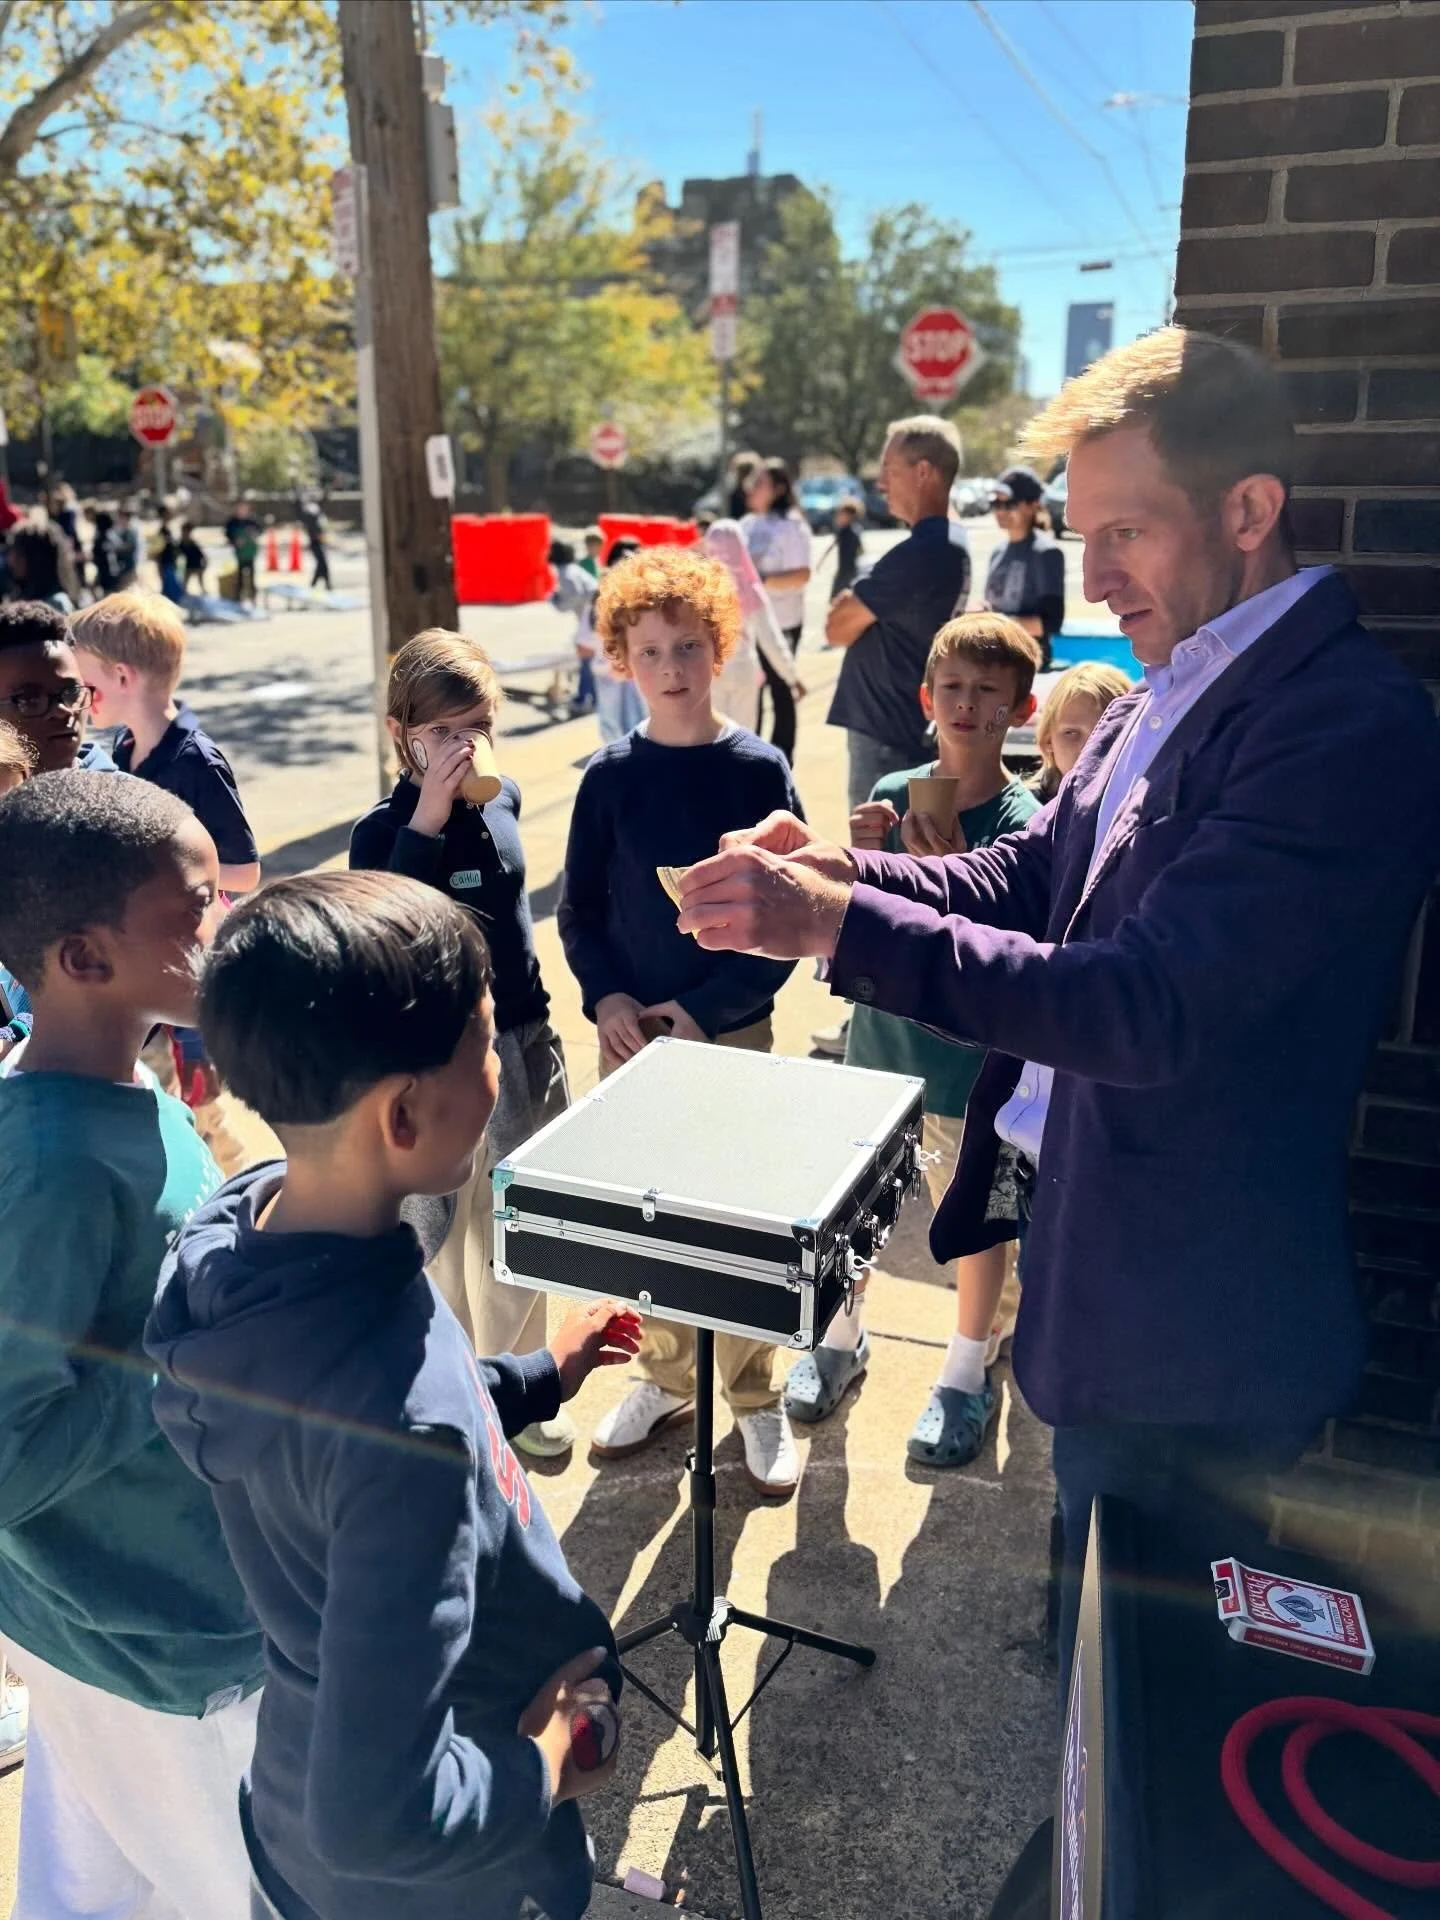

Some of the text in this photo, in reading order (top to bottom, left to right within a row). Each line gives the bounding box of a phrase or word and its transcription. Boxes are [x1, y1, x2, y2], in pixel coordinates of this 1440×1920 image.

[904, 329, 970, 362] STOP
[1245, 1573, 1281, 1622] BICYCLE
[1338, 1597, 1359, 1644] PLAYING CARDS
